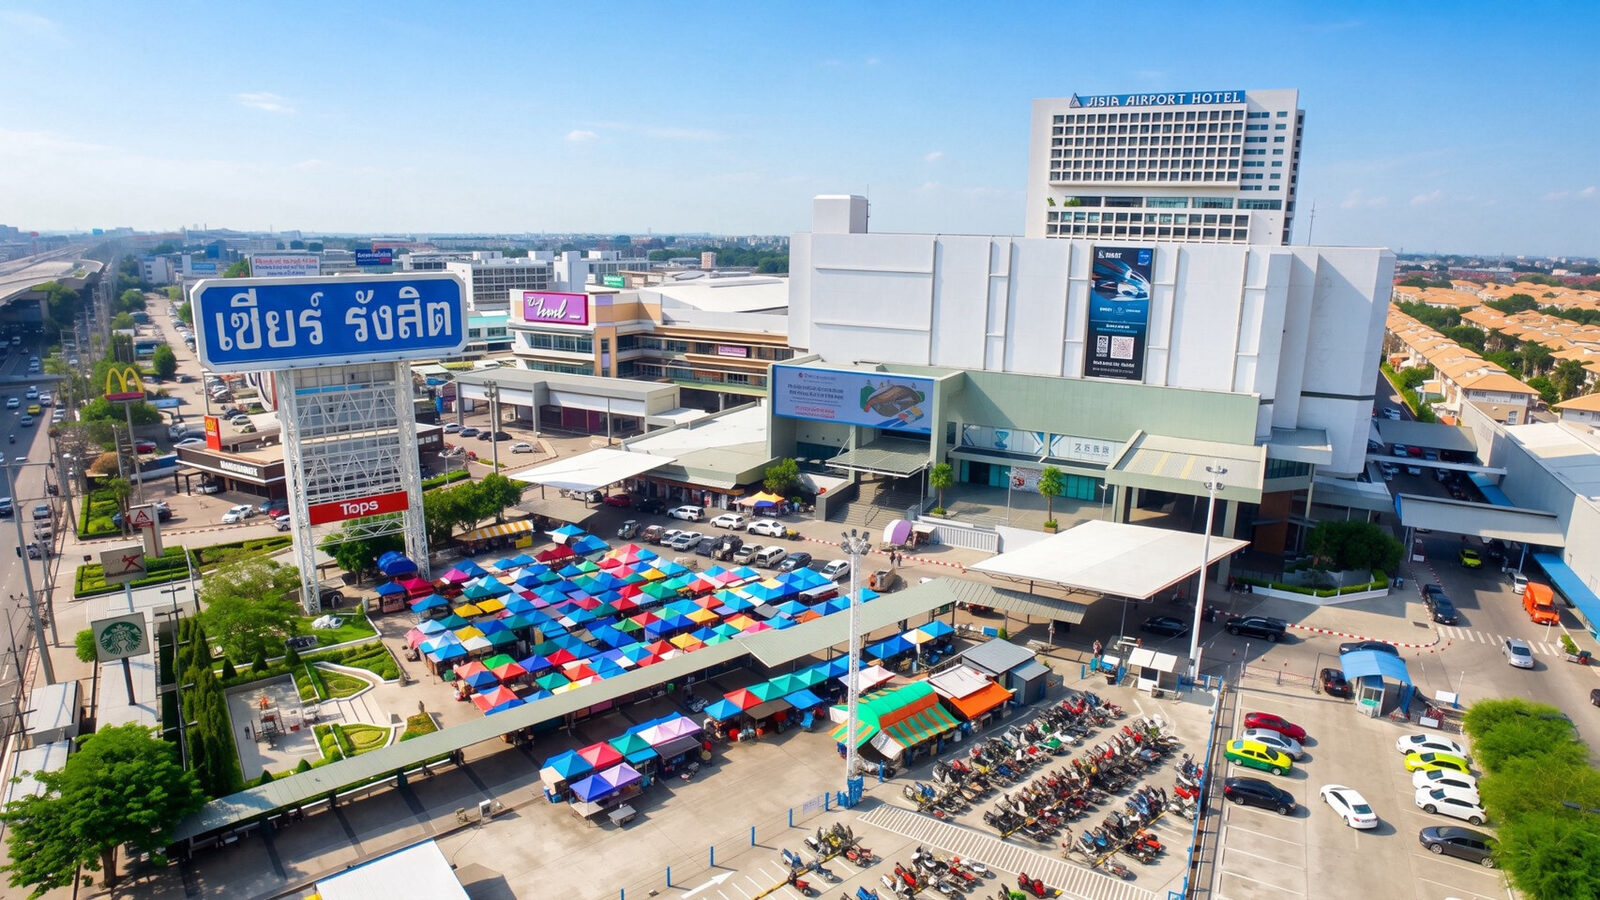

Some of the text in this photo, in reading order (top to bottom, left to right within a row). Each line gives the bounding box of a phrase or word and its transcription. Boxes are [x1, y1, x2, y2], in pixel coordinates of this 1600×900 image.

[1125, 93, 1187, 106] AIRPORT
[1192, 92, 1241, 104] HOTEL
[345, 286, 452, 342] รังสิต
[340, 500, 379, 516] Tops
